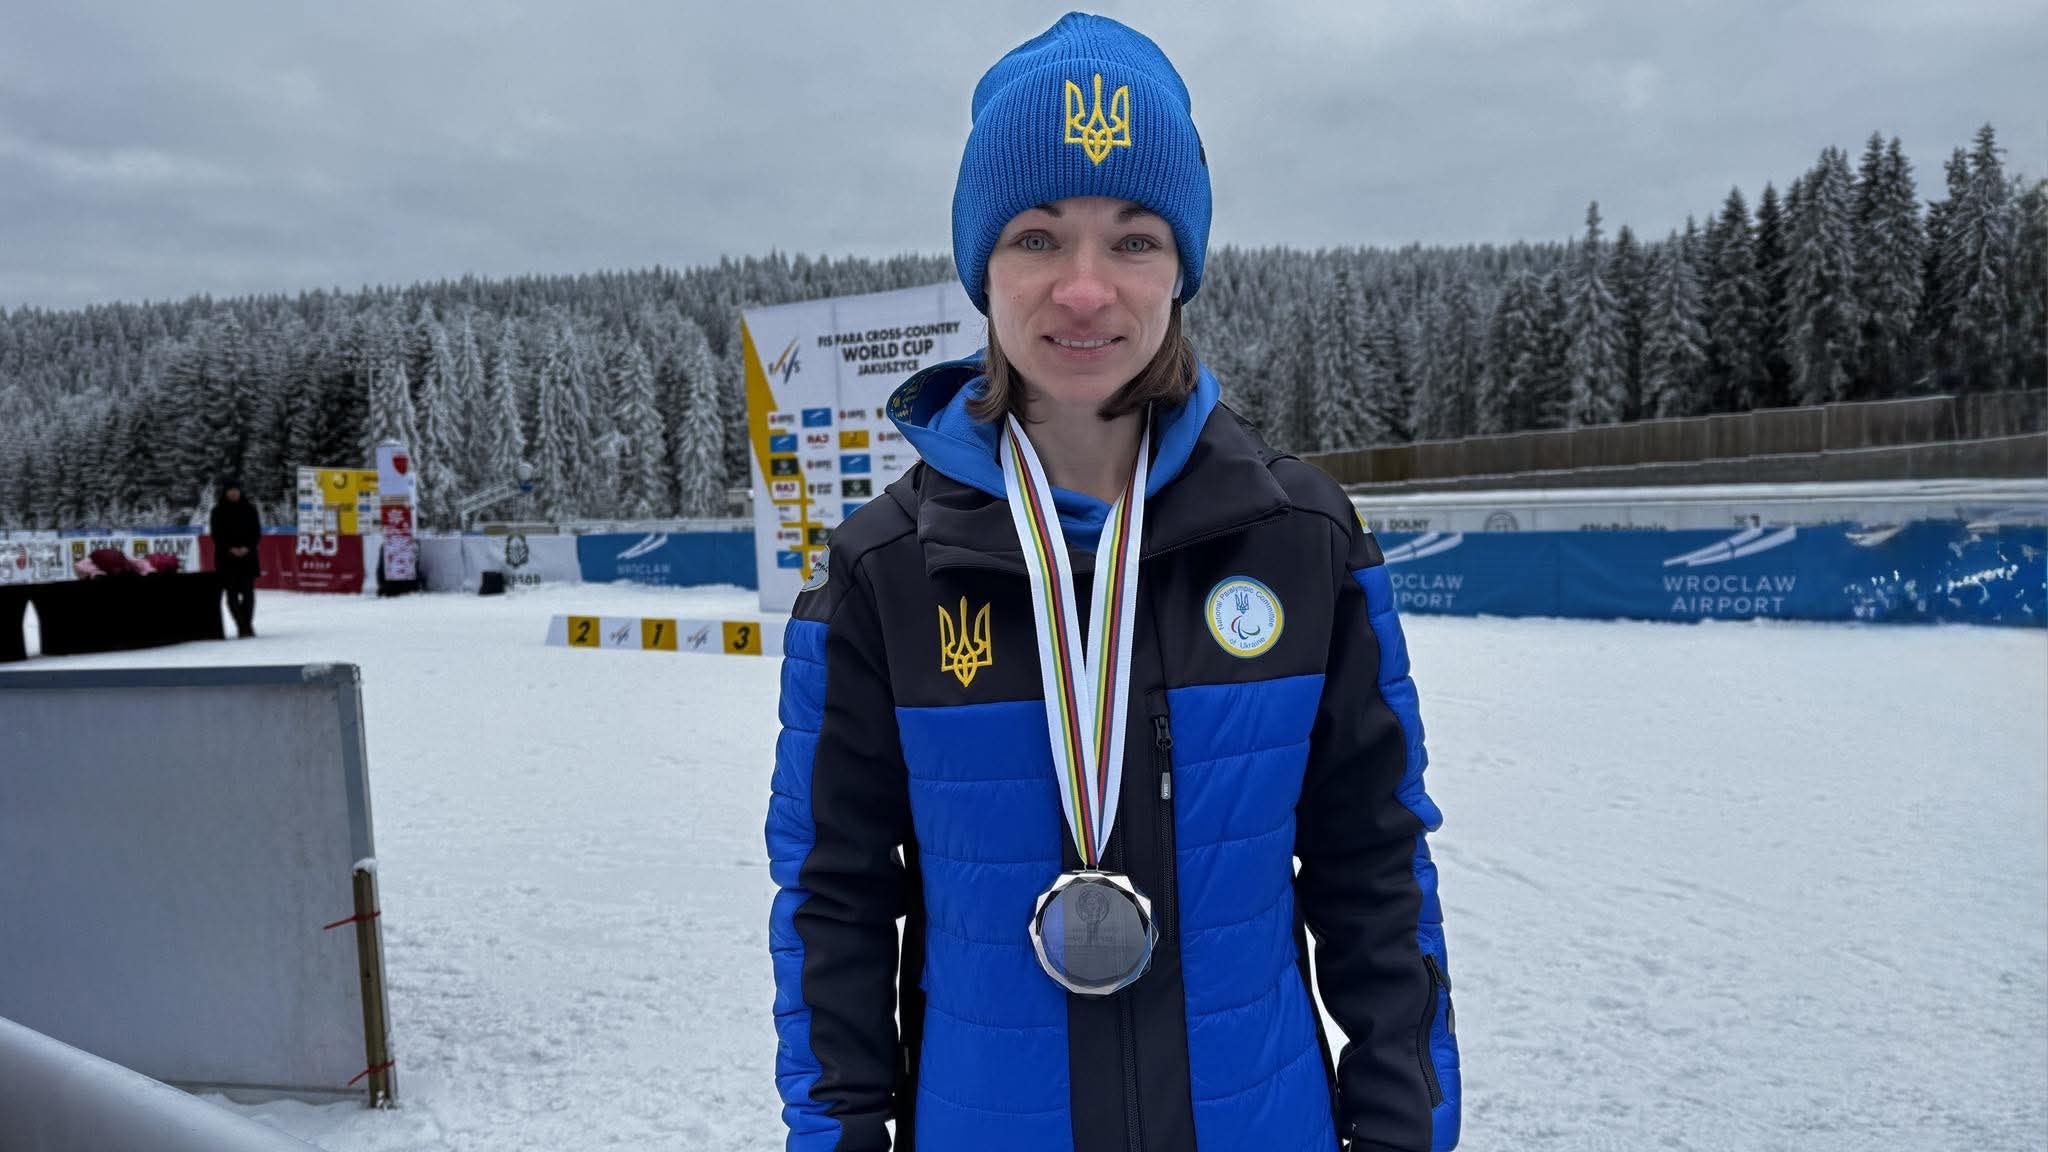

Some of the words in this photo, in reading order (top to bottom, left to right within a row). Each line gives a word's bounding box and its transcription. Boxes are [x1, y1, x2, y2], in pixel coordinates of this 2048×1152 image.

[817, 336, 833, 347] FIS
[835, 332, 863, 345] PARA
[865, 321, 960, 343] CROSS-COUNTRY
[842, 343, 898, 362] WORLD
[903, 338, 934, 356] CUP
[858, 359, 919, 376] JAKUSZYCE
[296, 535, 338, 556] RAJ
[1392, 574, 1464, 590] OCLAW
[1664, 575, 1796, 593] WROCLAW
[1220, 585, 1254, 601] Paralympic
[1671, 596, 1785, 614] AIRPORT
[575, 620, 592, 643] 2
[652, 623, 664, 646] 1
[733, 626, 751, 650] 3
[1239, 637, 1266, 649] Ukraine
